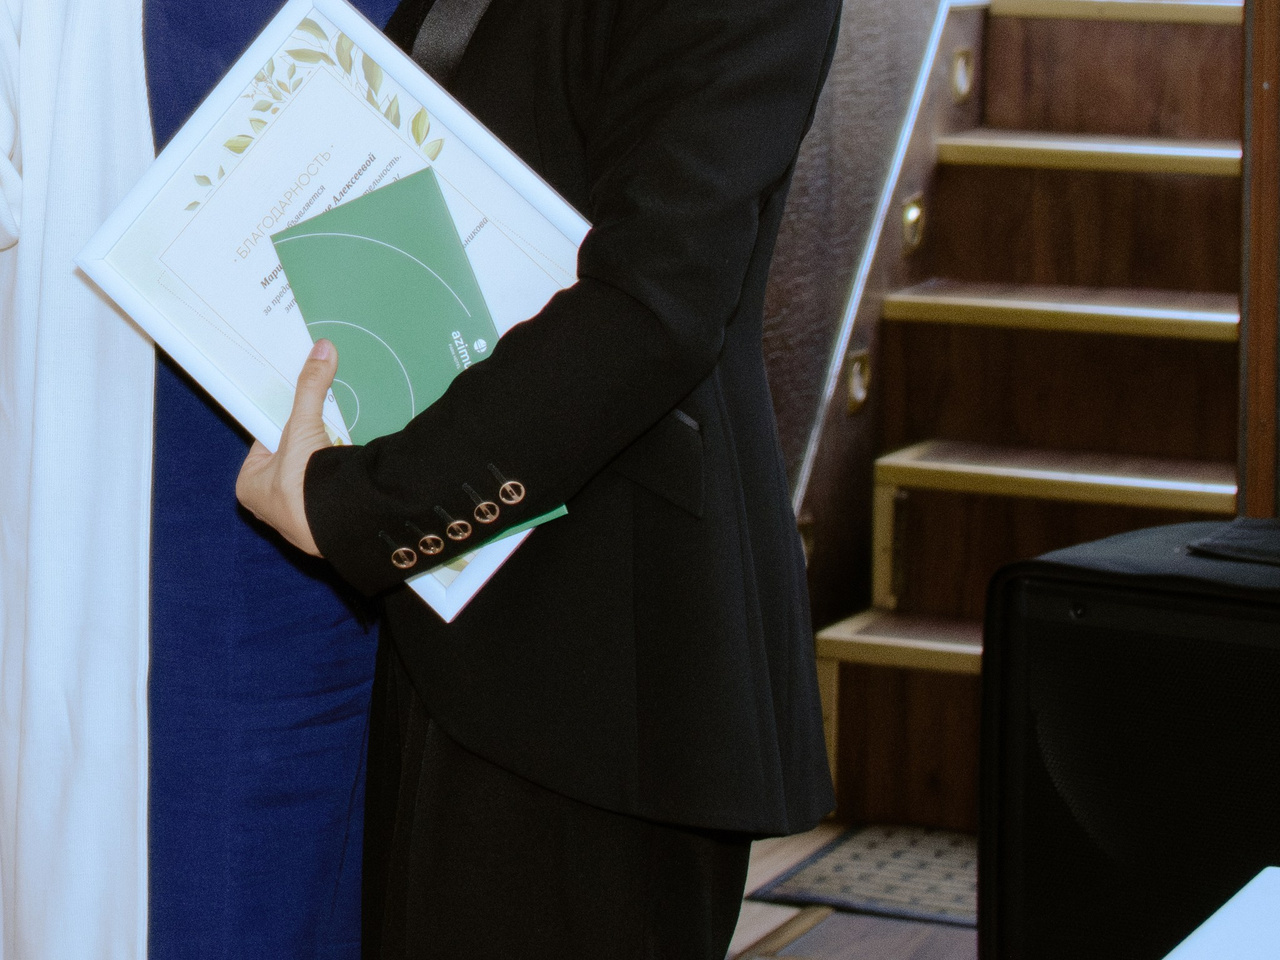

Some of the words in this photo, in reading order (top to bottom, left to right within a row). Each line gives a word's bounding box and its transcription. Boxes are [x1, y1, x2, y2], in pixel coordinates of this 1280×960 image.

[236, 151, 331, 259] БЛАГОДАРНОСТЬ
[260, 263, 283, 289] Мари
[332, 152, 377, 206] Алексеевой
[263, 305, 272, 316] за
[271, 283, 291, 304] преда
[363, 155, 402, 195] тельность.
[285, 184, 326, 229] бъявляется
[463, 217, 488, 248] ьникова
[451, 330, 472, 369] azimu
